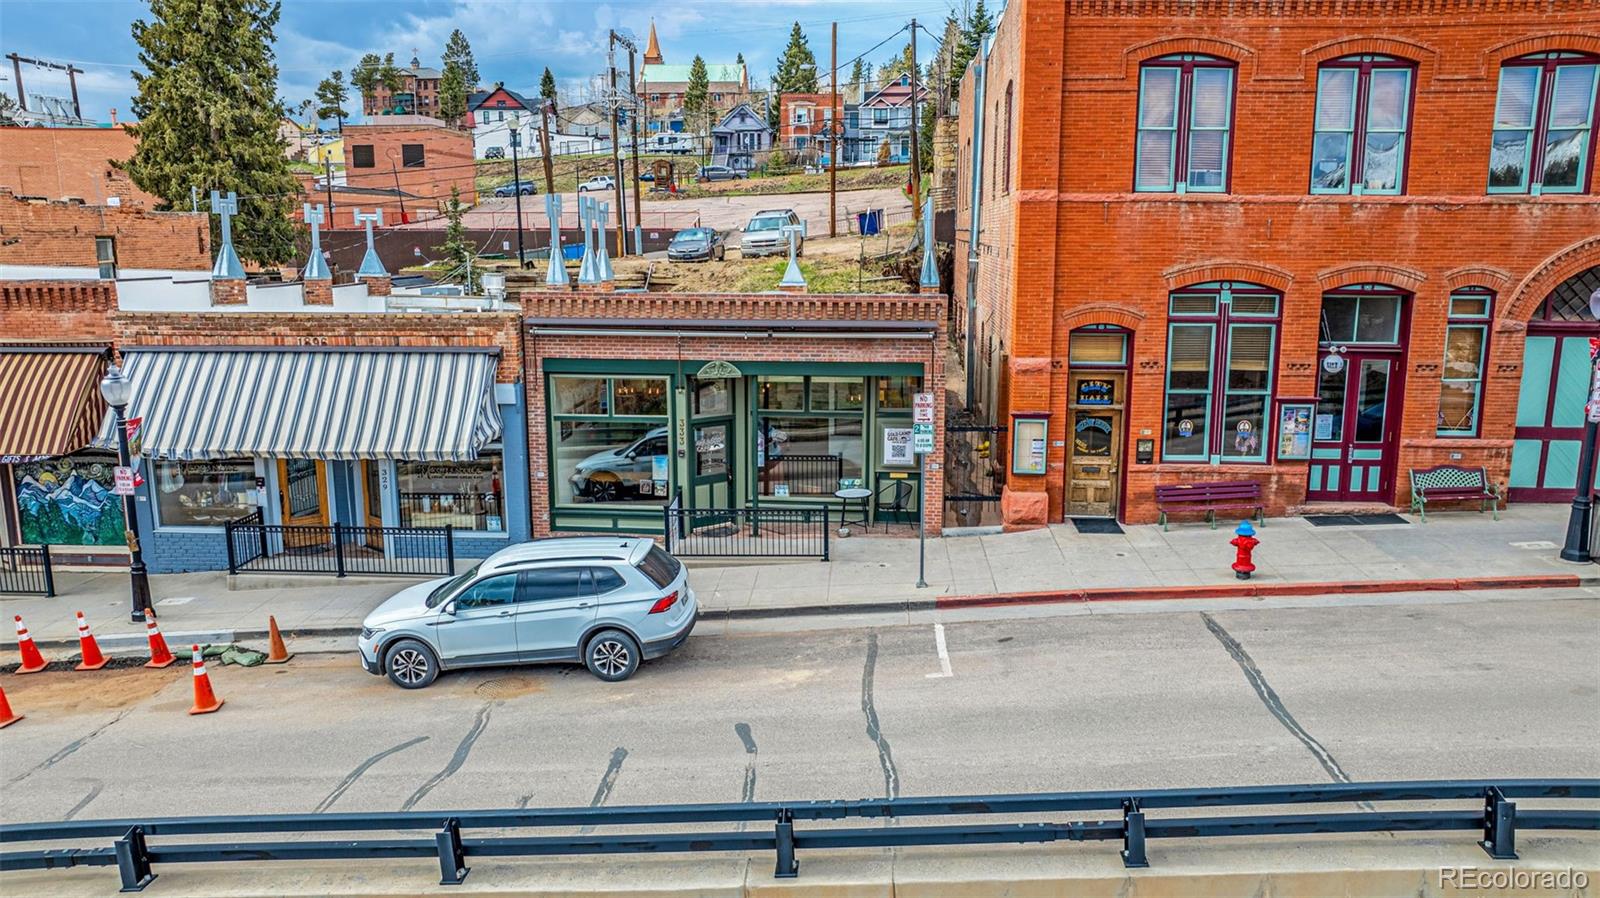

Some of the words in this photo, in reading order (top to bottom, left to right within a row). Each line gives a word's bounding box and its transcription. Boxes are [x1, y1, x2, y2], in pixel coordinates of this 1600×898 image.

[297, 336, 328, 346] 1896
[1080, 381, 1112, 393] CITY
[1, 455, 21, 463] GIFTS
[381, 468, 389, 490] 329
